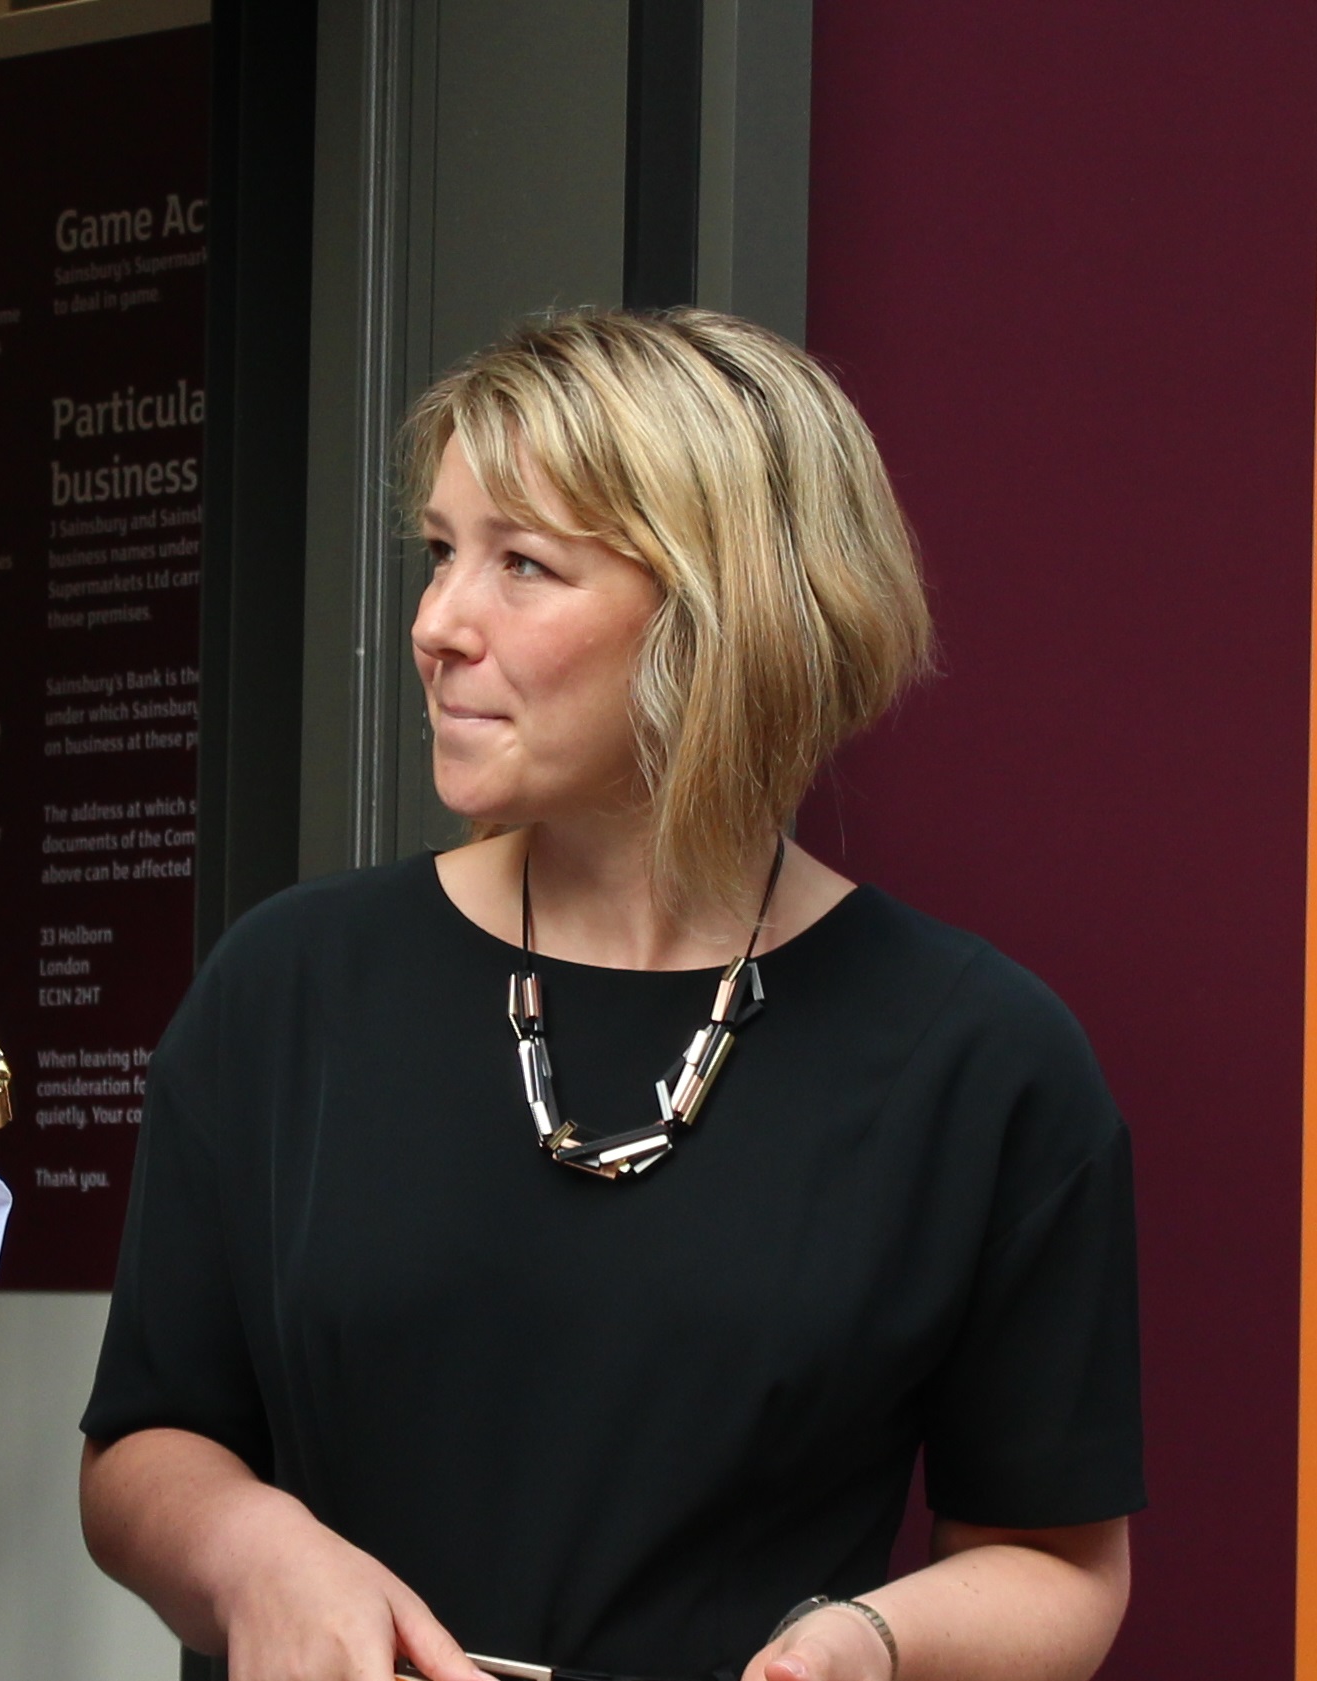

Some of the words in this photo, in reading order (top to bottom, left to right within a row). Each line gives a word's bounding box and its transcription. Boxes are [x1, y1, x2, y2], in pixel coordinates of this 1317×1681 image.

[55, 207, 153, 253] Game
[162, 193, 210, 239] Ac
[53, 258, 132, 286] Sainsbury's
[53, 300, 68, 316] to
[70, 291, 100, 314] deal
[103, 290, 118, 309] in
[120, 287, 161, 312] game.
[51, 379, 205, 440] Particula
[50, 453, 198, 507] business
[50, 519, 57, 540] J
[59, 514, 128, 538] Sainsbury
[130, 507, 157, 531] and
[48, 544, 108, 569] business
[110, 544, 157, 564] names
[158, 536, 200, 559] under
[47, 572, 144, 602] Supermarkets
[146, 567, 171, 590] Ltd
[47, 609, 85, 630] these
[87, 604, 153, 631] premises.
[46, 673, 123, 698] Sainsbury's
[126, 667, 164, 690] Bank
[165, 665, 178, 687] is
[45, 705, 86, 727] under
[88, 701, 130, 723] which
[44, 740, 63, 758] on
[64, 735, 124, 756] business
[126, 731, 142, 752] at
[144, 728, 184, 750] these
[44, 803, 68, 824] The
[70, 799, 124, 823] address
[126, 798, 142, 820] at
[144, 795, 186, 817] which
[42, 829, 118, 854] documents
[120, 827, 137, 850] of
[138, 826, 163, 849] the
[41, 863, 82, 885] above
[84, 863, 111, 882] can
[112, 857, 130, 880] be
[132, 855, 193, 880] affected
[39, 927, 56, 947] 33
[58, 923, 114, 946] Holborn
[39, 954, 91, 978] London
[38, 986, 73, 1008] EC1N
[74, 984, 103, 1006] 2HT
[37, 1047, 77, 1069] When
[79, 1046, 131, 1073] leaving
[36, 1074, 132, 1098] consideration
[35, 1103, 88, 1131] quietly.
[91, 1103, 125, 1125] Your
[126, 1106, 143, 1124] co
[35, 1165, 78, 1189] Thank
[79, 1169, 111, 1193] you.
